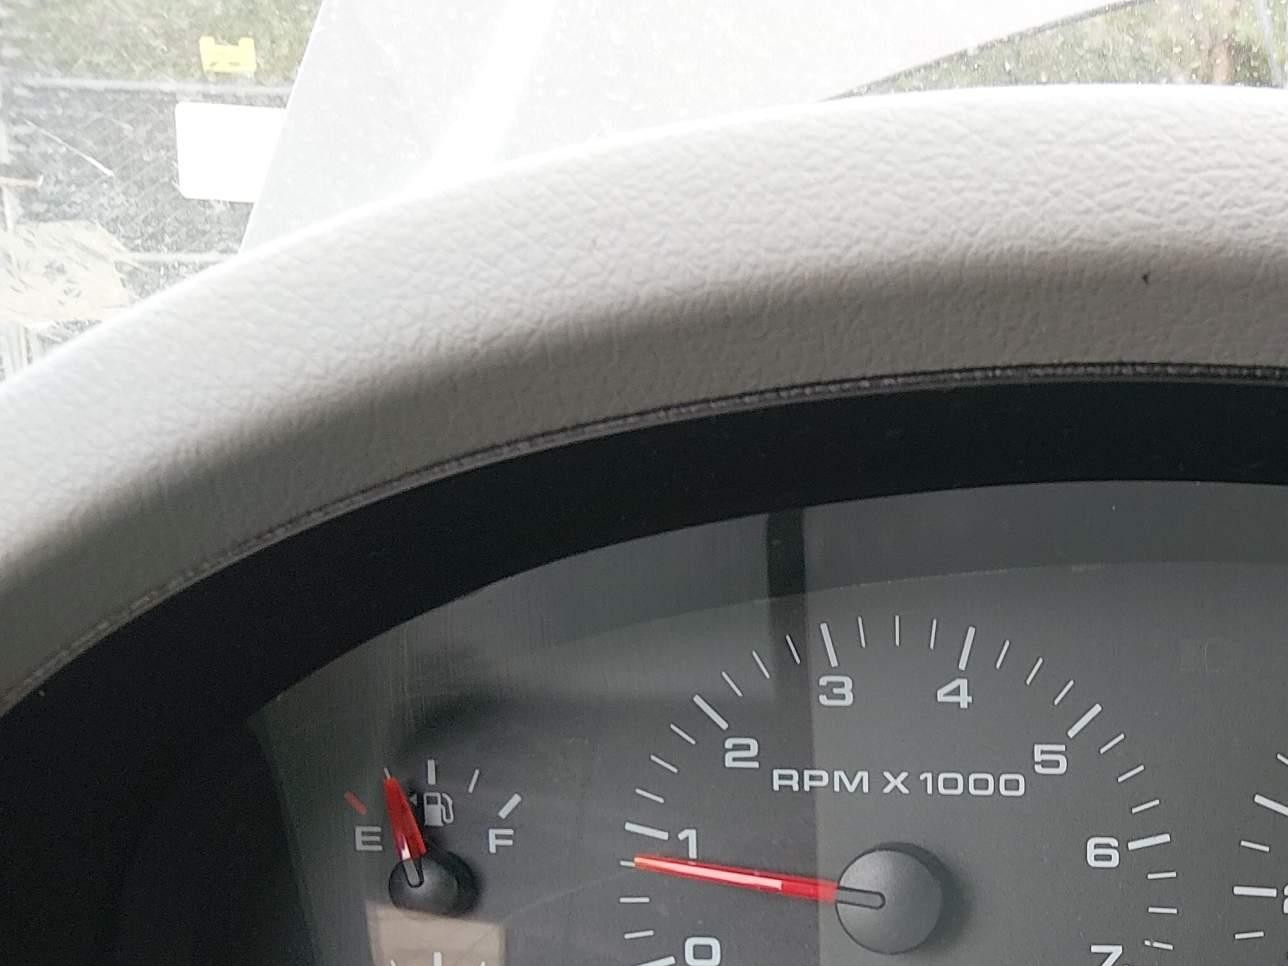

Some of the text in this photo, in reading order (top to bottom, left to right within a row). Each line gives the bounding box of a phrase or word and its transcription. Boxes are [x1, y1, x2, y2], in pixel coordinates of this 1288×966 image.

[819, 676, 853, 706] 3
[937, 679, 972, 708] 4
[725, 738, 759, 768] 2
[1034, 744, 1066, 775] 5
[773, 770, 1024, 796] RPM X 1000
[356, 826, 382, 851] E
[489, 829, 513, 853] F
[678, 829, 697, 858] 1
[1087, 837, 1119, 867] 6
[685, 937, 720, 966] 0
